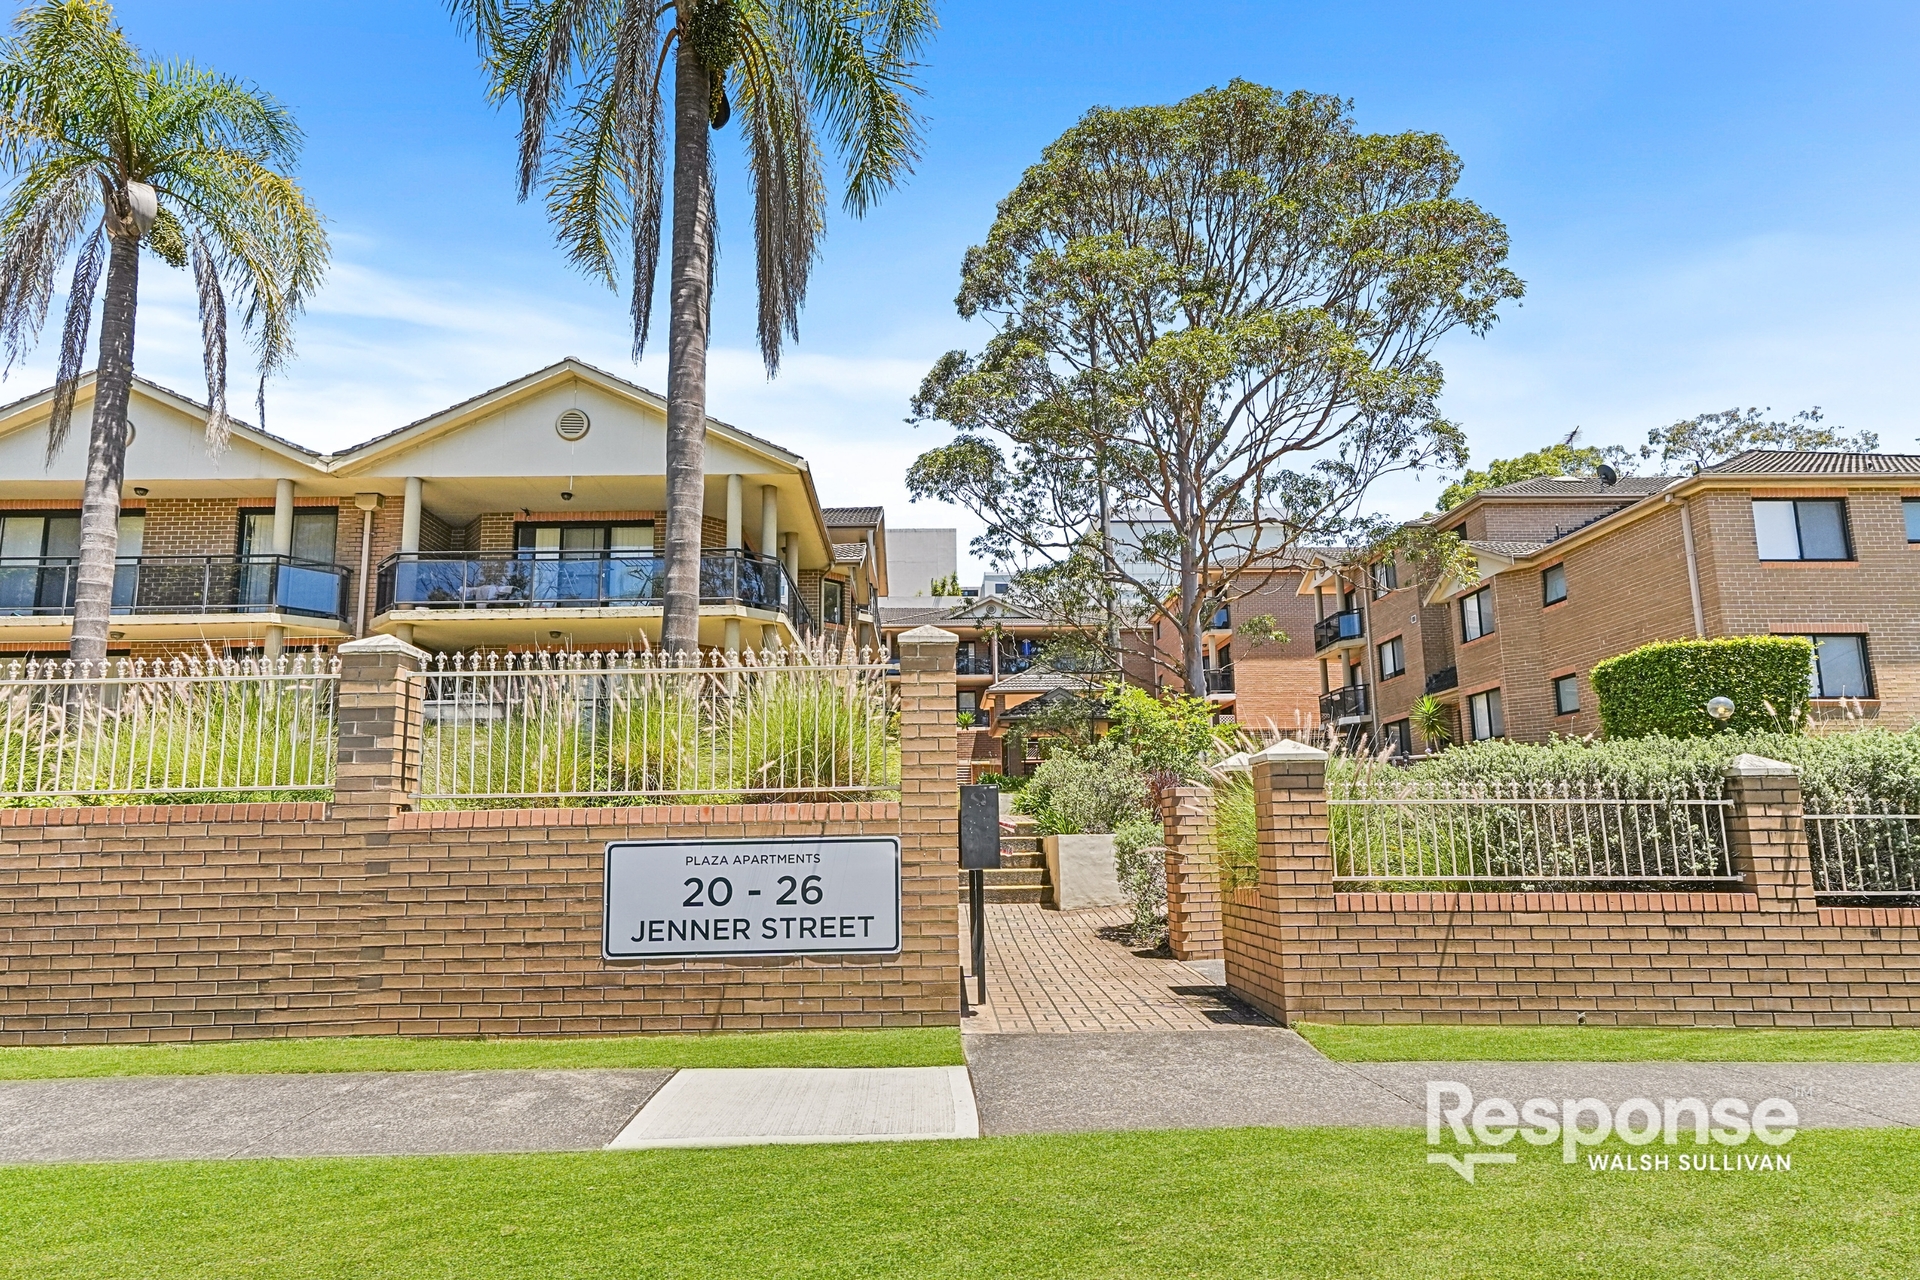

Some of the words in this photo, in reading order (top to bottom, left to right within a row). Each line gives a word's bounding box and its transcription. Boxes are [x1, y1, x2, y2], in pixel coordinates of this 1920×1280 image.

[685, 855, 728, 866] PLAZA
[733, 853, 821, 865] APARTMENTS
[683, 877, 733, 906] 20
[776, 875, 823, 905] 26
[631, 918, 750, 942] JENNER
[761, 916, 875, 939] STREET
